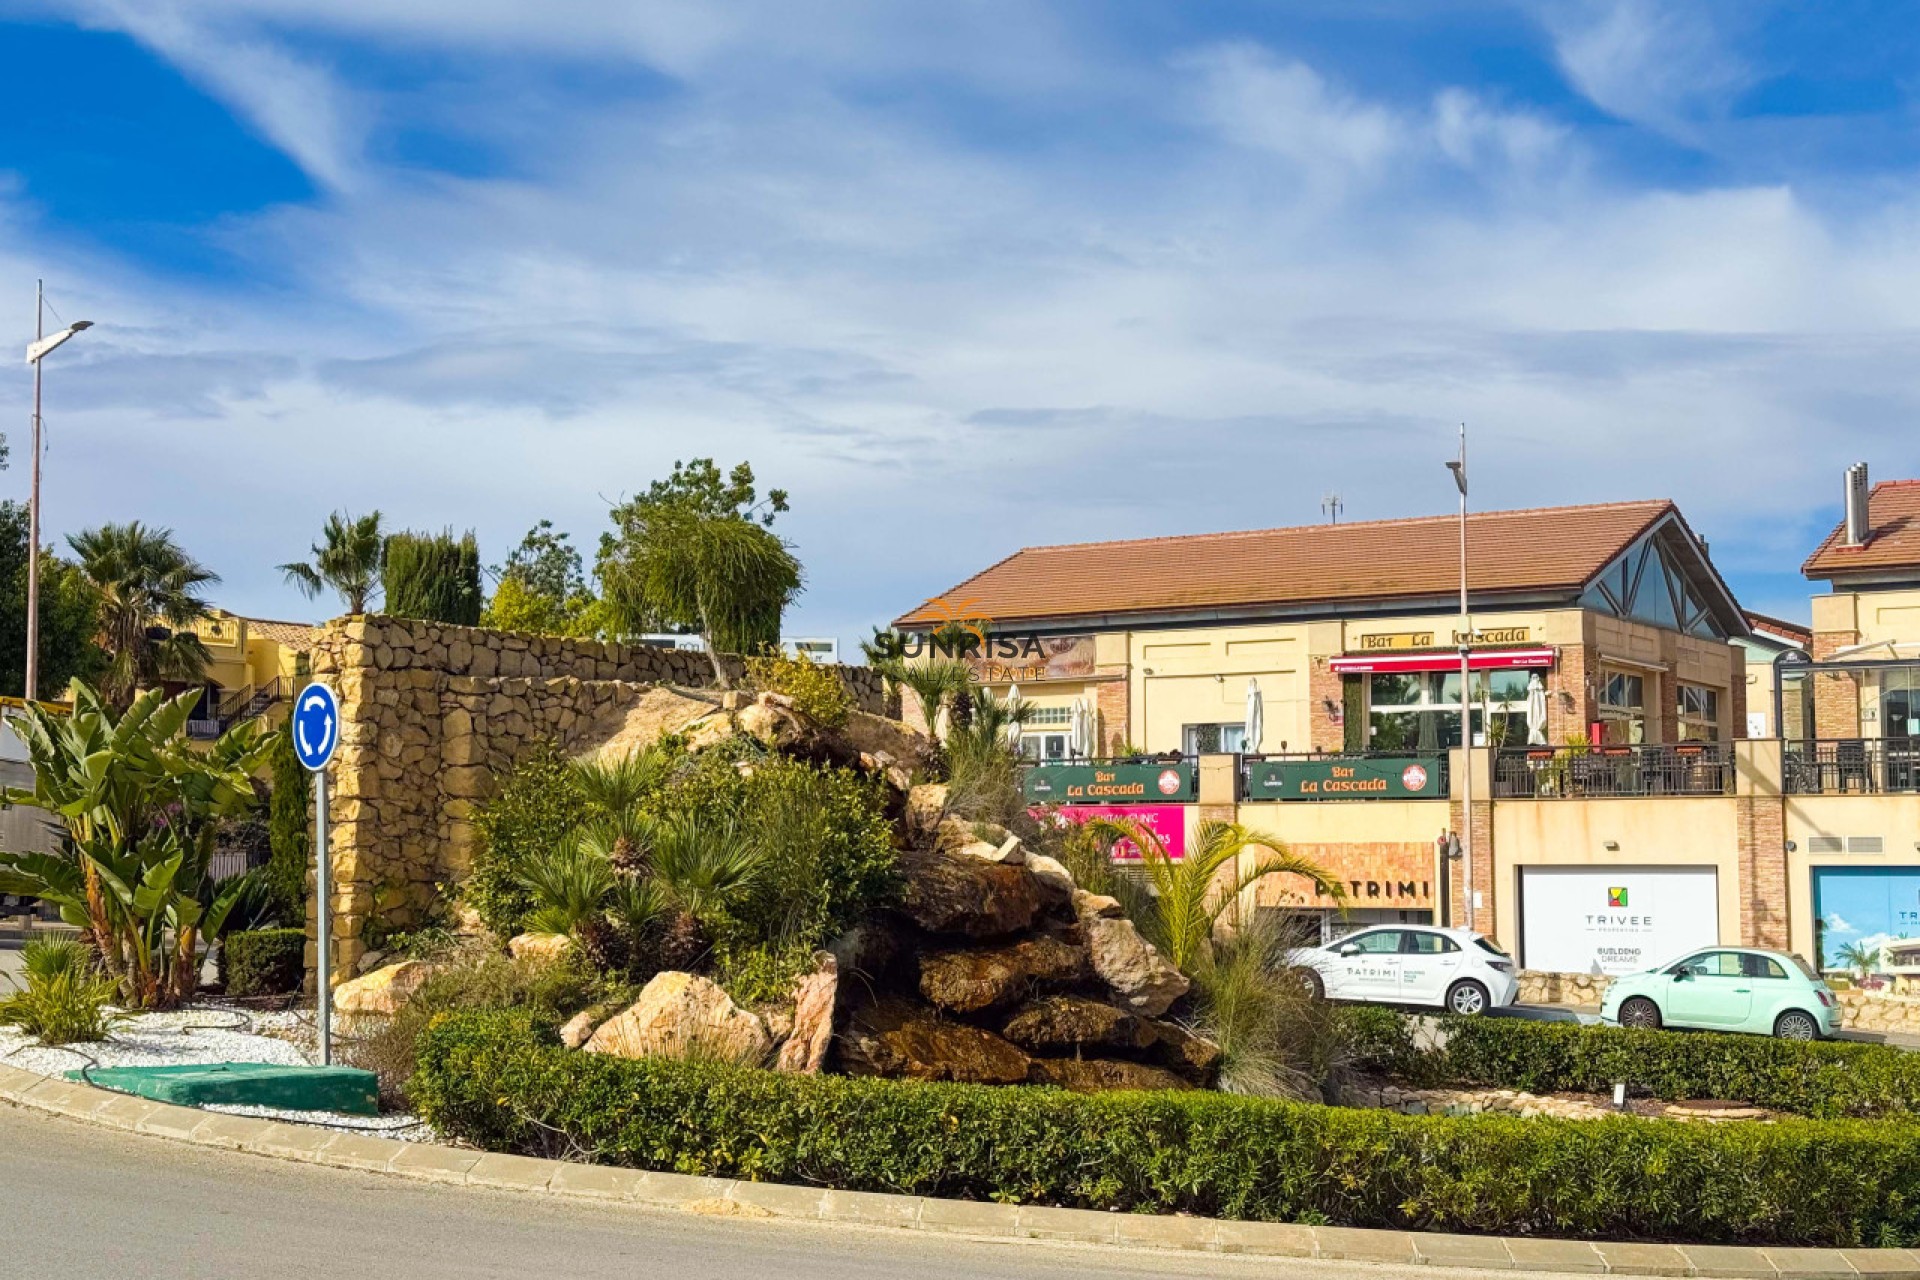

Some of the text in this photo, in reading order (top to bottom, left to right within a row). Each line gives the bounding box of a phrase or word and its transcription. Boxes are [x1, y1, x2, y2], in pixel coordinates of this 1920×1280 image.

[1366, 635, 1394, 648] Bar
[1412, 634, 1430, 646] La
[1095, 770, 1116, 783] Bar
[1331, 766, 1354, 778] Bar
[1067, 785, 1083, 797] La
[1087, 782, 1145, 796] Cascada
[1300, 778, 1387, 793] La Cascada
[1585, 915, 1652, 925] TRIVEE
[1597, 947, 1642, 956] BUILDING
[1346, 967, 1396, 977] PATRIMI
